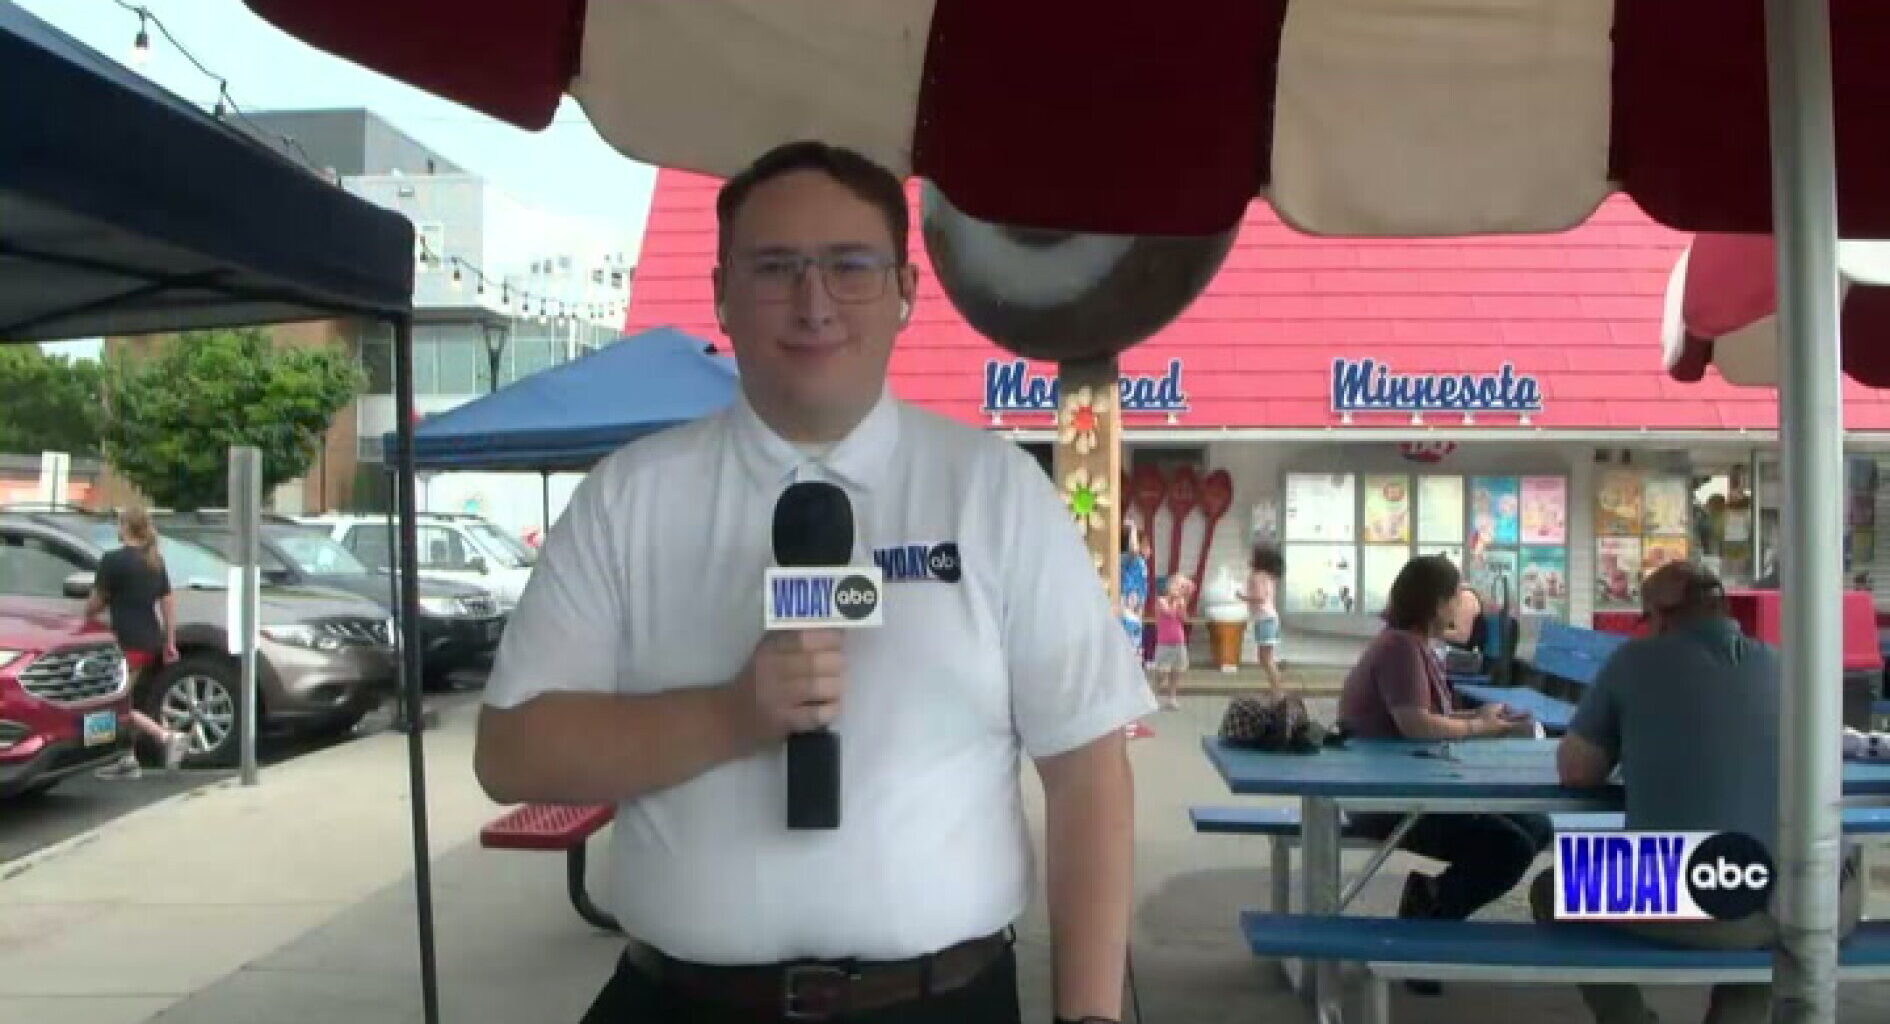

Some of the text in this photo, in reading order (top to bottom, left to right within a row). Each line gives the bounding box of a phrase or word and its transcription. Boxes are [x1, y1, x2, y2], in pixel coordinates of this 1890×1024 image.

[984, 358, 1542, 411] Moead Minnesota
[873, 544, 954, 577] WDAY ab
[773, 576, 875, 618] WDAY abc
